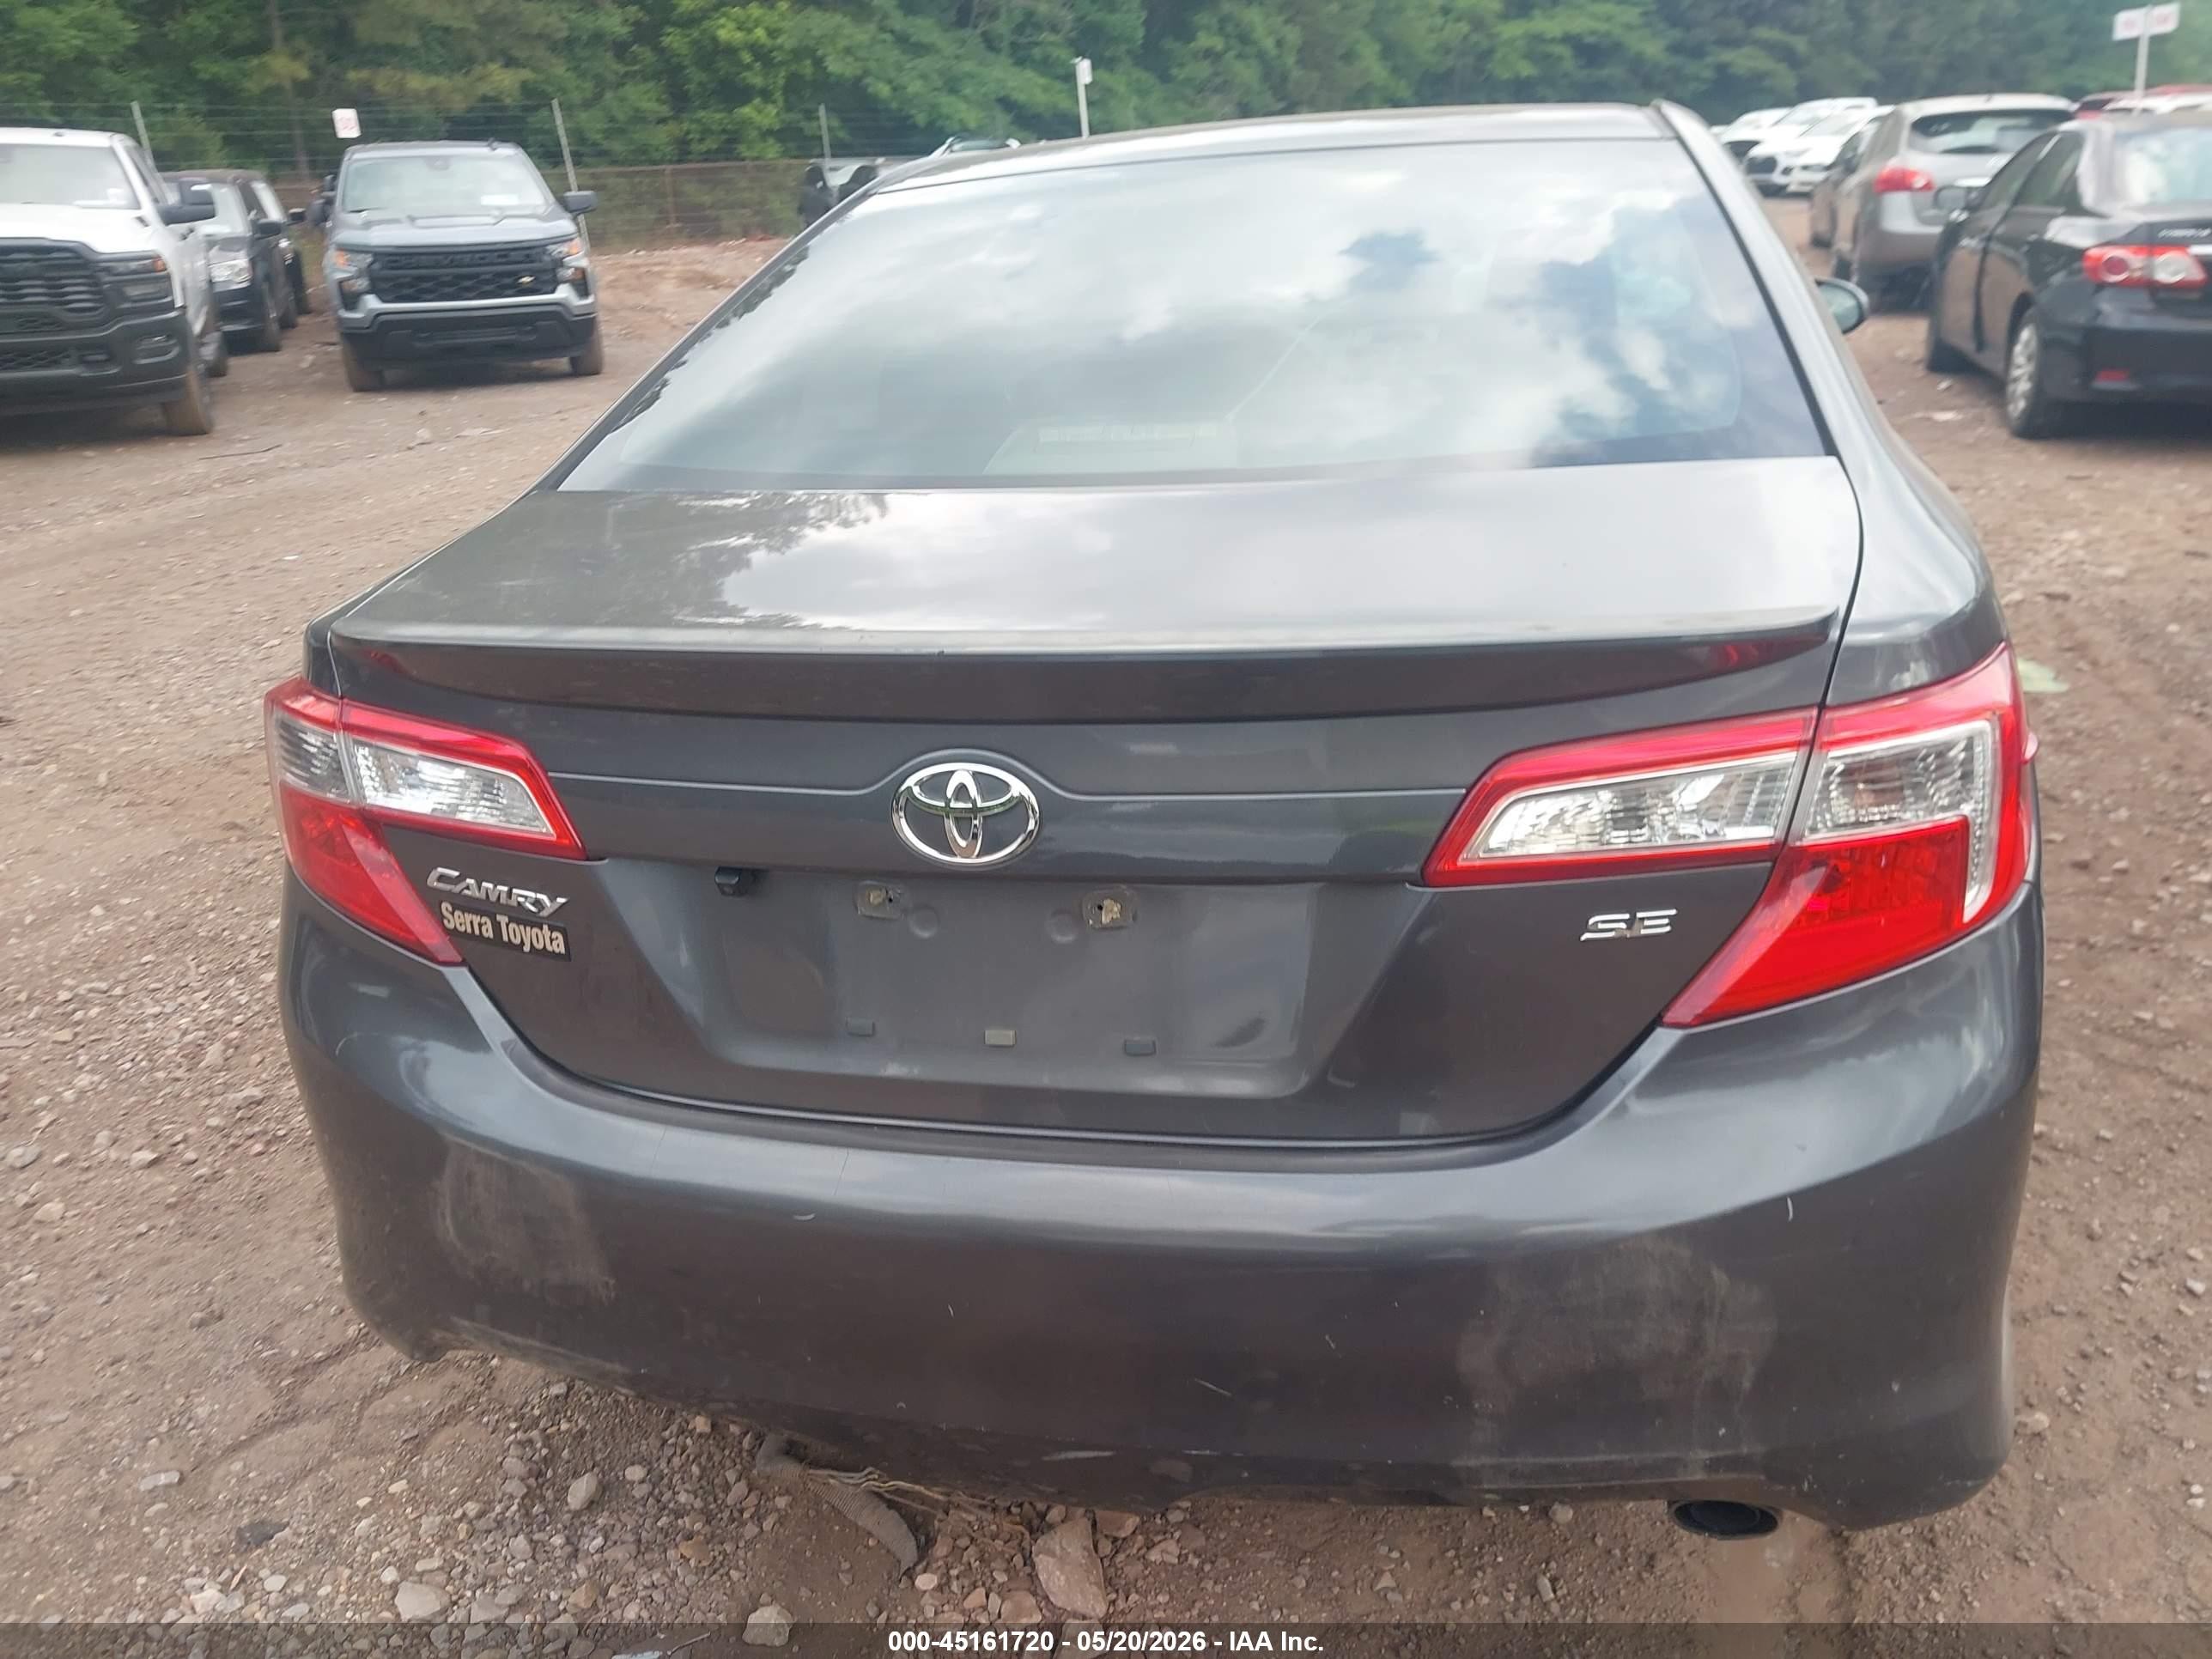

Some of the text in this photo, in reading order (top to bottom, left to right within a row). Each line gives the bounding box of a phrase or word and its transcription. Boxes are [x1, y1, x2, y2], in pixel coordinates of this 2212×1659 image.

[427, 866, 570, 917] CAMRY
[440, 902, 566, 954] Serra Toyota
[1579, 908, 1678, 942] SE
